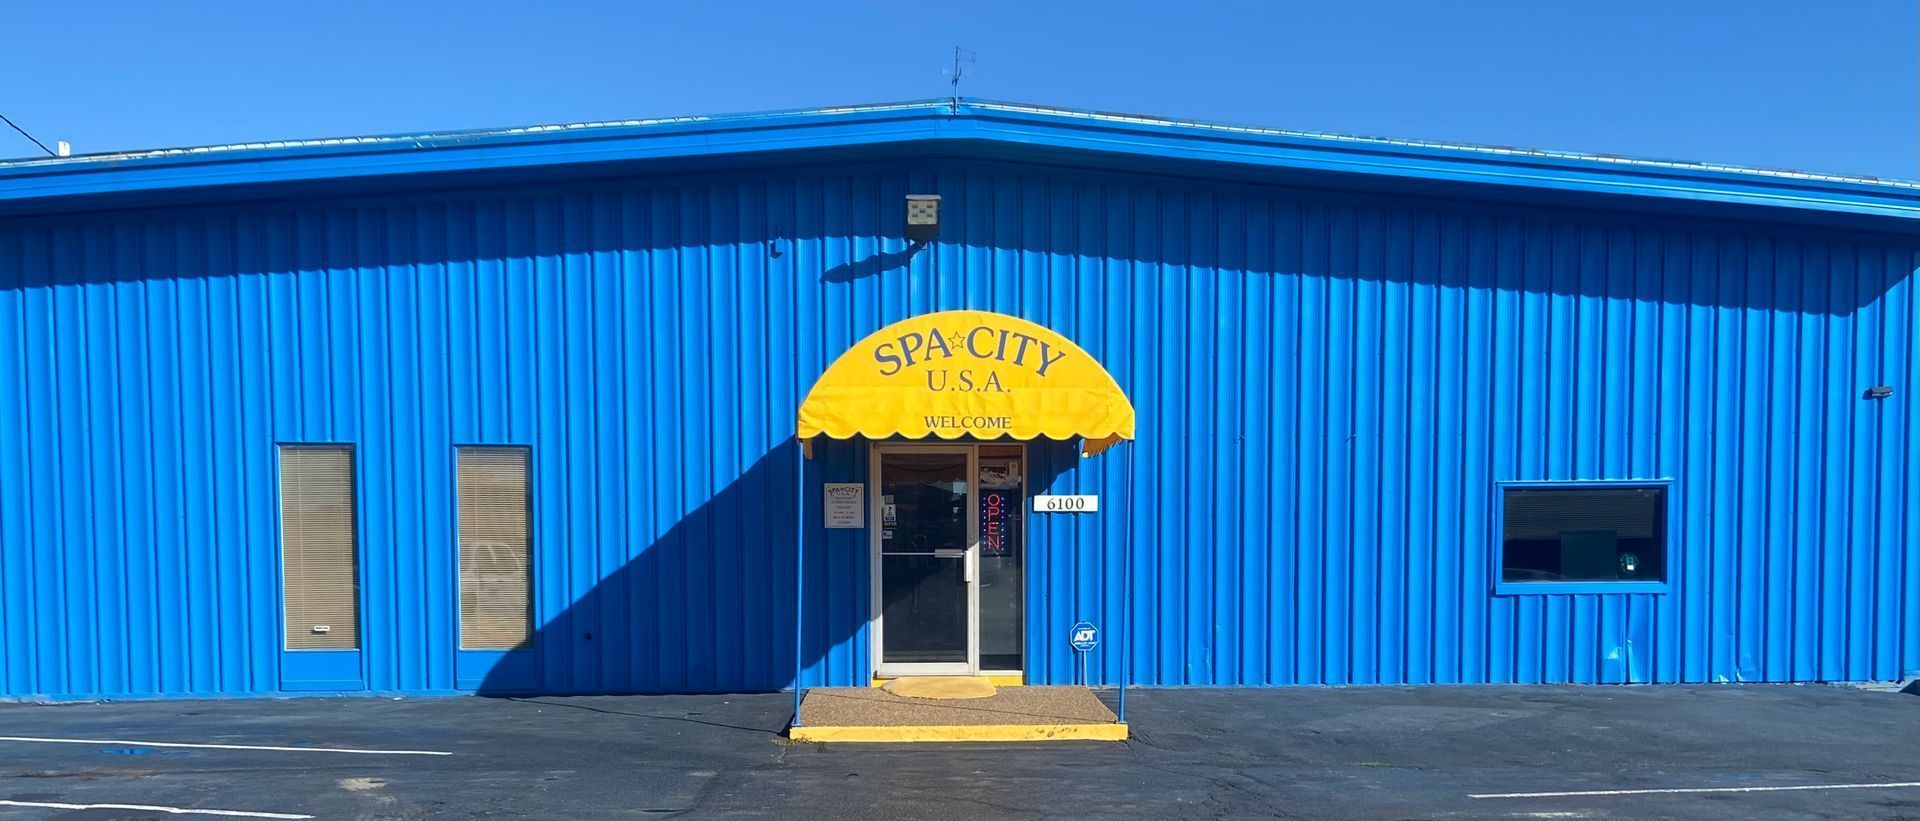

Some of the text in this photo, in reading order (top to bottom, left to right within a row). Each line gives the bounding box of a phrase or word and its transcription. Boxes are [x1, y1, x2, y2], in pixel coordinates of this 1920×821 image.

[874, 326, 1066, 377] SPA CITY
[927, 370, 1011, 393] U.S.A.
[924, 416, 1012, 429] WELCOME
[1047, 497, 1085, 510] 6100
[987, 493, 1001, 550] OPEN
[1073, 630, 1096, 642] ADT
